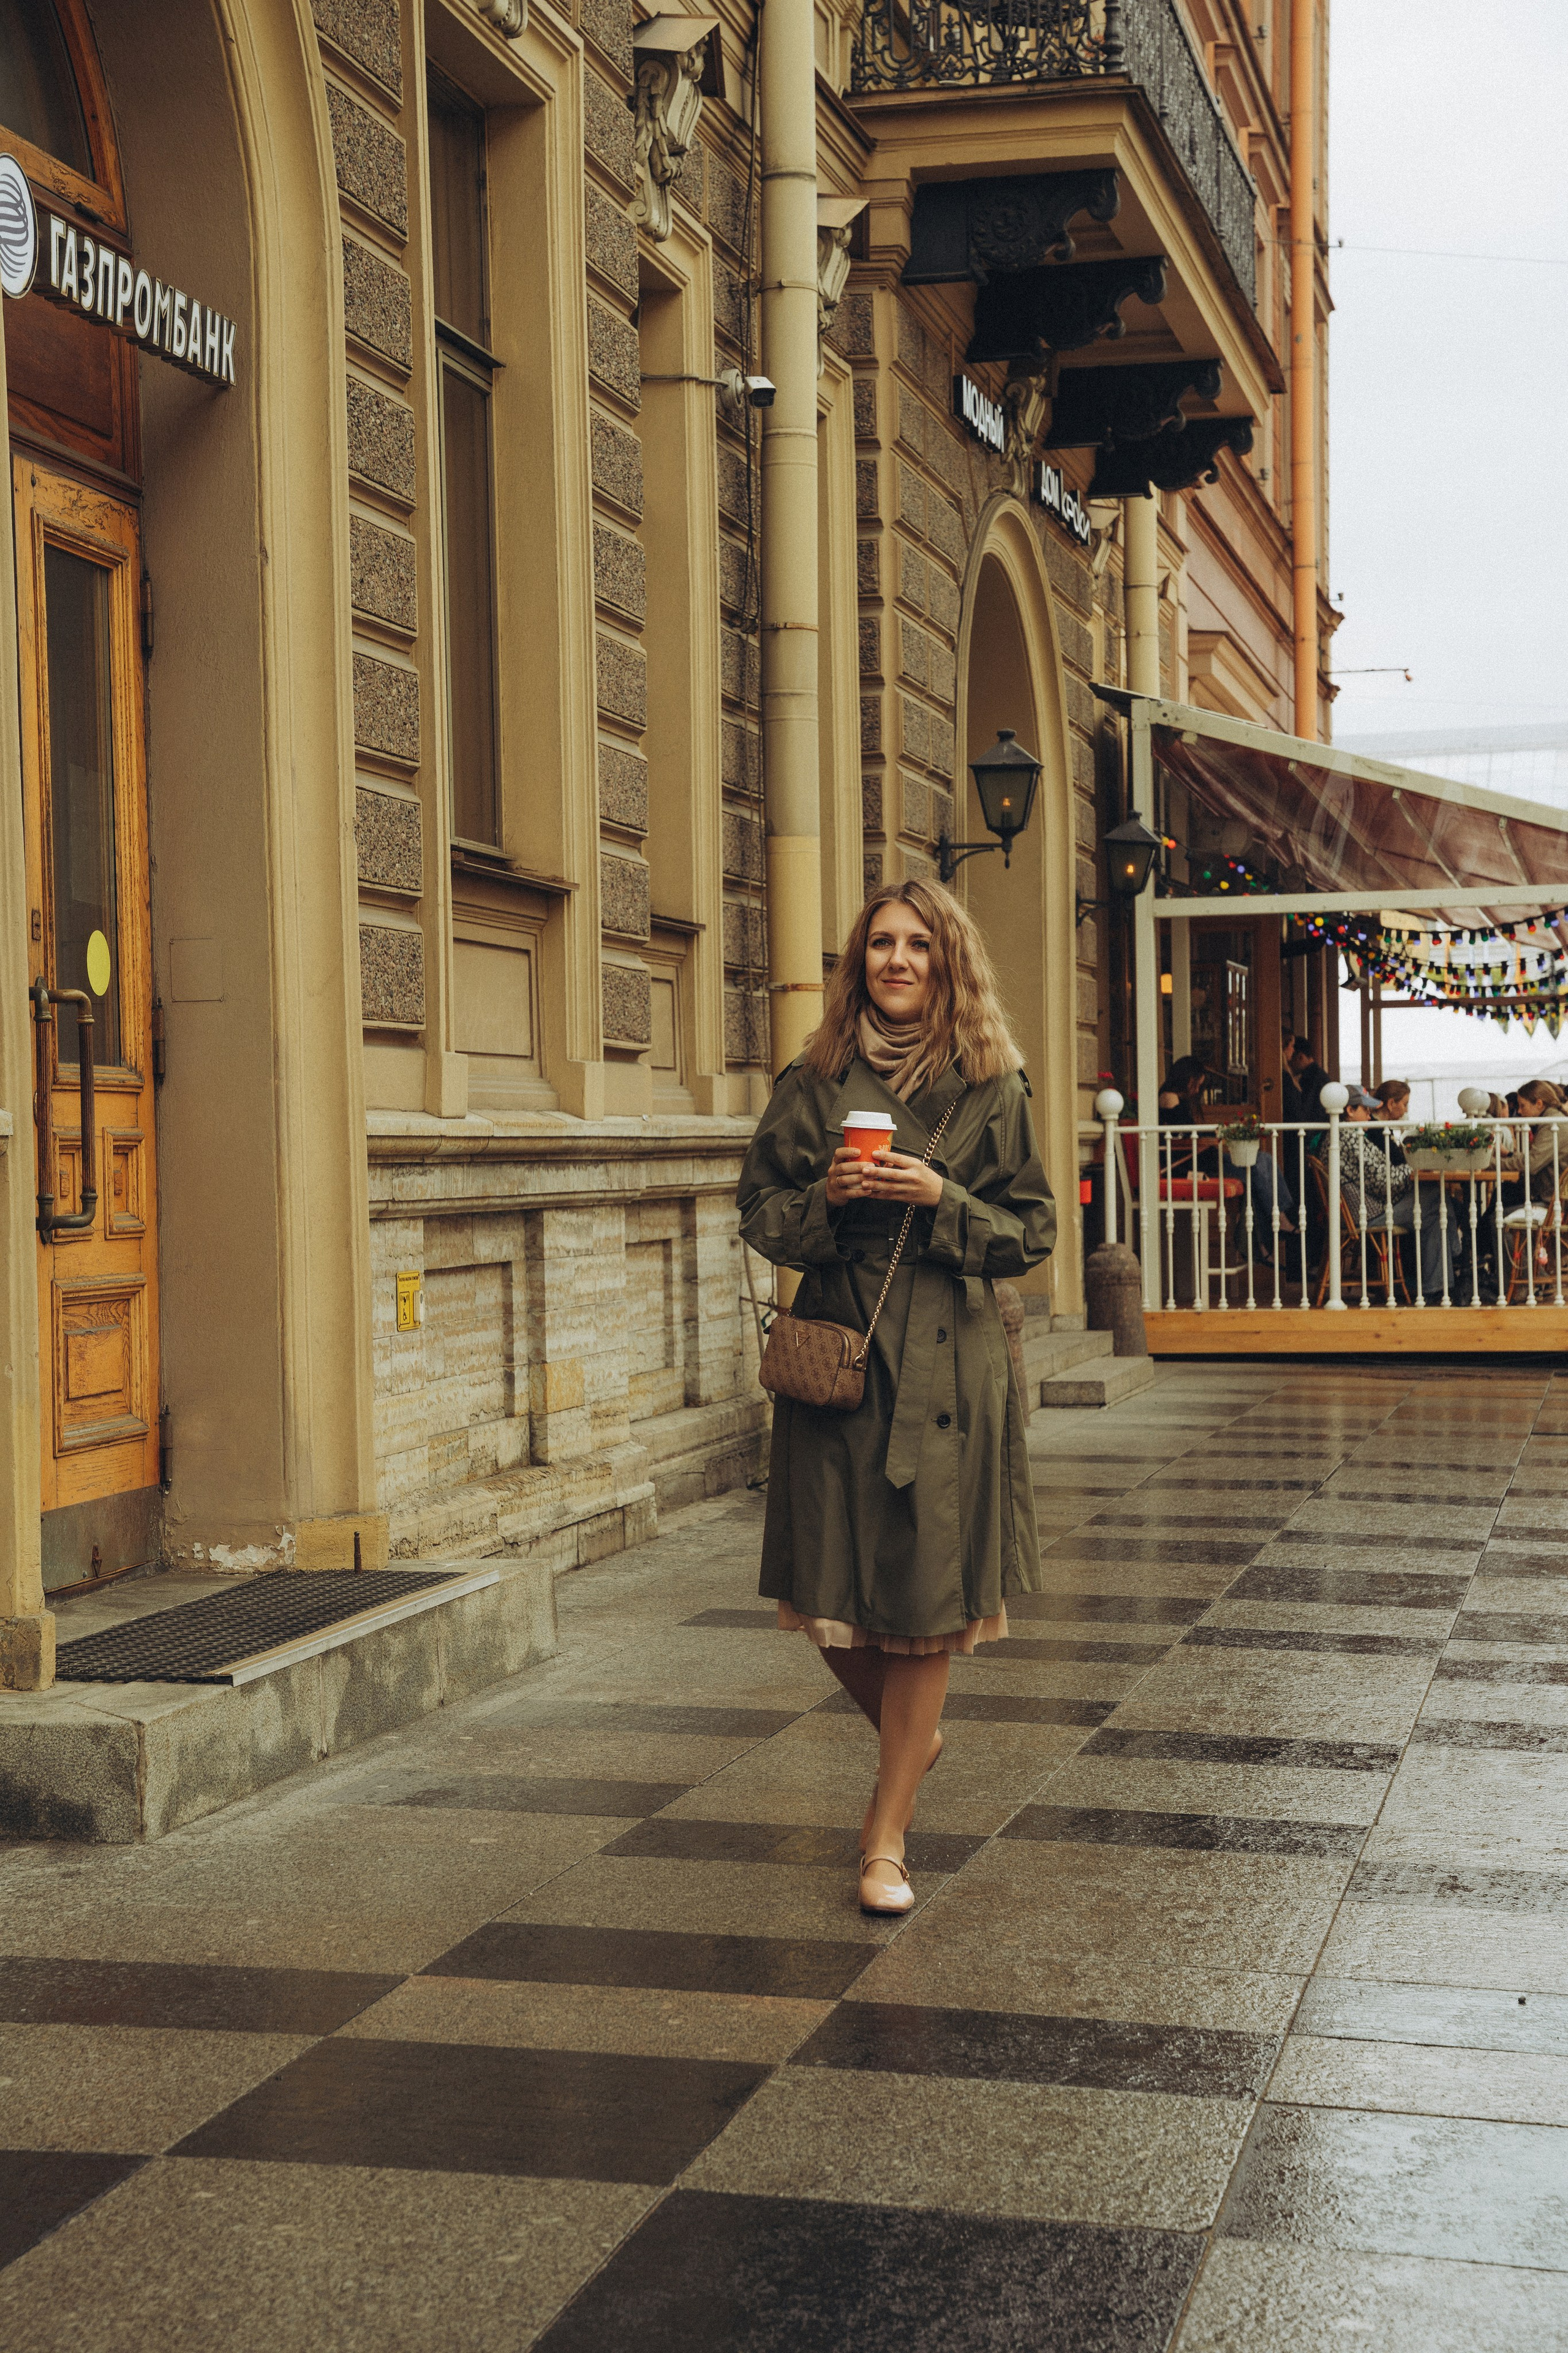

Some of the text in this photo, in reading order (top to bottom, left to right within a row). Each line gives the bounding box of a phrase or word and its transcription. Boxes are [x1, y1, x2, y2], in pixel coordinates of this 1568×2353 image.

[50, 214, 237, 386] ГАЗПРОМБАНК
[962, 374, 1005, 453] МОДНЫЙ
[1041, 460, 1060, 511] ДОМ
